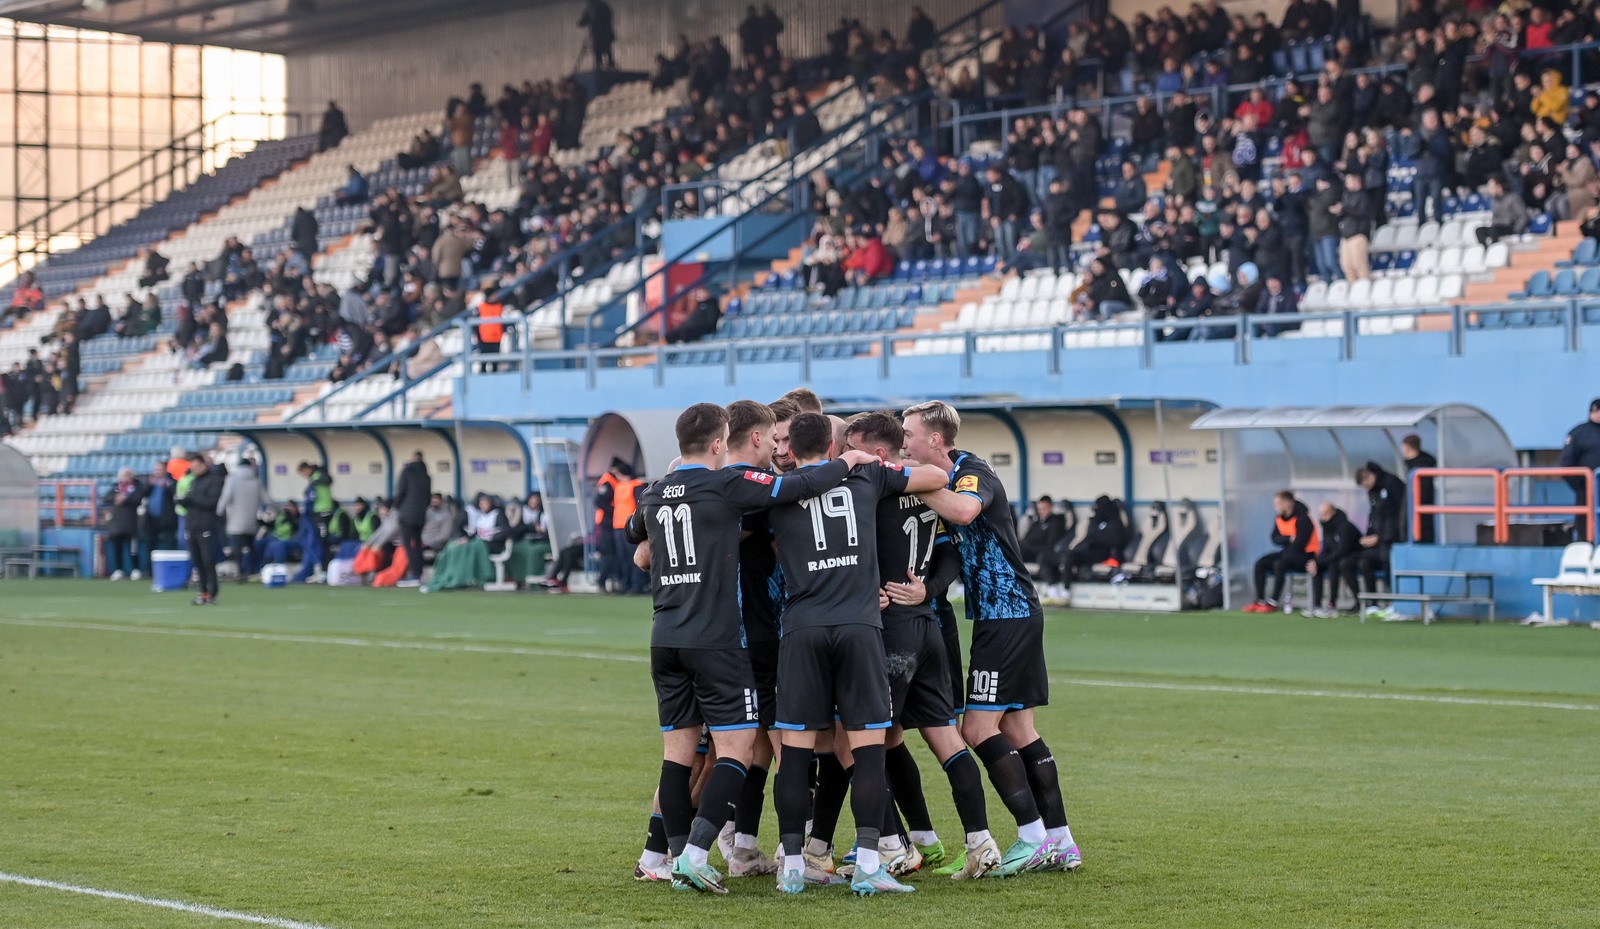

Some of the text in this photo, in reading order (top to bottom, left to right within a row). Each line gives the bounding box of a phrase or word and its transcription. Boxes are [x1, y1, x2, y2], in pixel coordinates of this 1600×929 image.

[656, 503, 696, 567] 11
[798, 486, 858, 551] 19
[807, 555, 859, 571] RADNIK
[902, 510, 938, 574] 17
[661, 573, 701, 585] RADNIK
[972, 669, 990, 693] 10
